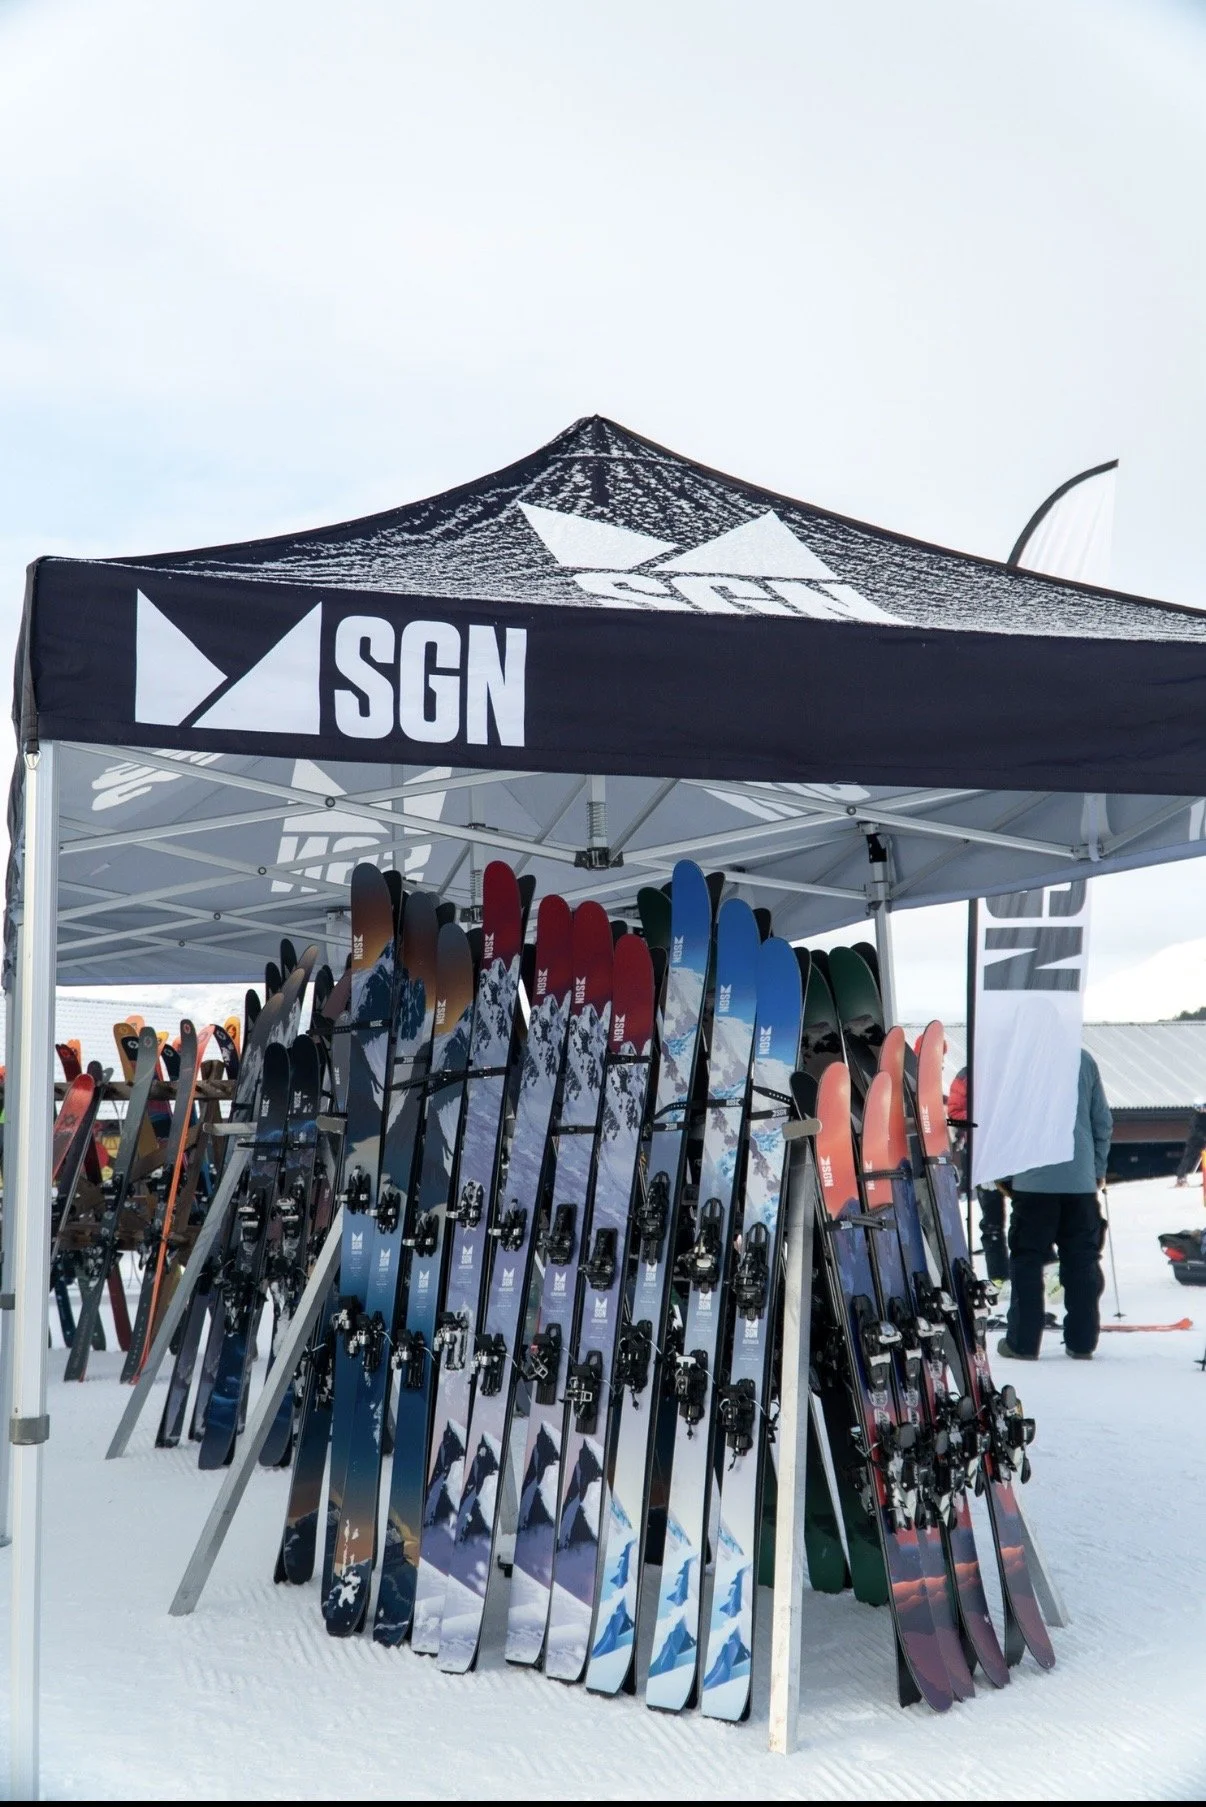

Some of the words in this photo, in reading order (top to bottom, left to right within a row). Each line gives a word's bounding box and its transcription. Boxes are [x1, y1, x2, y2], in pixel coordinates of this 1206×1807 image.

[334, 615, 528, 748] SGN
[575, 984, 586, 1004] SGN
[719, 993, 731, 1012] SGN
[614, 1021, 625, 1042] SGN
[759, 1034, 772, 1054] SGN
[821, 1165, 834, 1187] SGN
